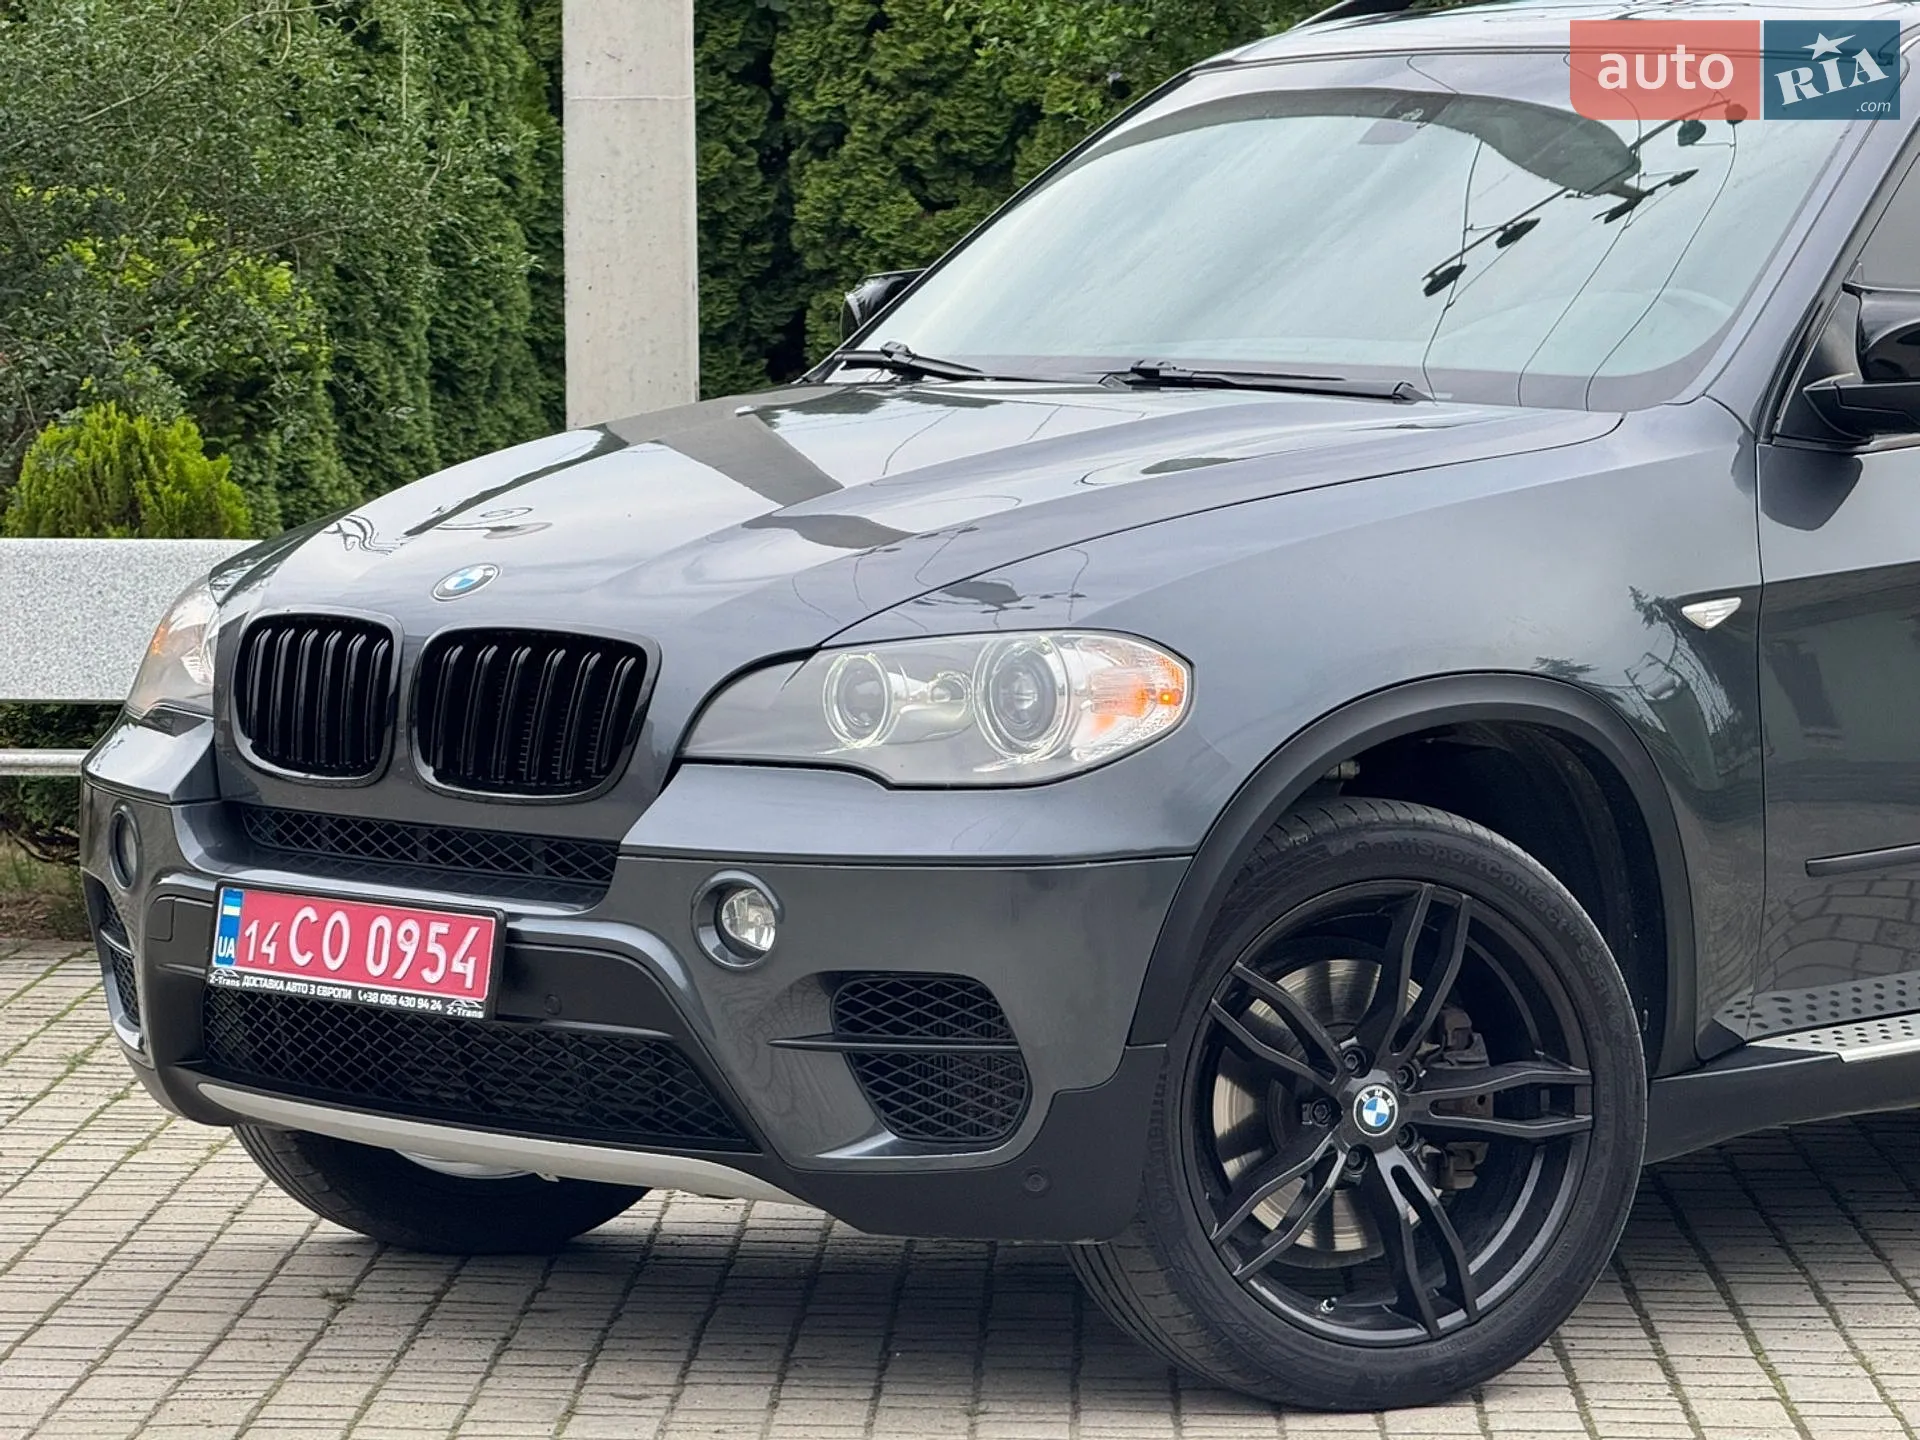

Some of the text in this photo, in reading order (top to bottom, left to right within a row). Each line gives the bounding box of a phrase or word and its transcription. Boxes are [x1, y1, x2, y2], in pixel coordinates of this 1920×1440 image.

[217, 935, 236, 959] UA
[244, 905, 481, 989] 14 CO 0954
[241, 975, 285, 991] ДОСТАВКА
[285, 982, 308, 994] АВТО
[316, 986, 352, 999] ЄВРОПИ
[379, 992, 398, 1006] 096
[398, 996, 417, 1008] 430
[417, 998, 430, 1010] 94
[429, 1000, 443, 1012] 24
[446, 1006, 485, 1019] Z-Trans
